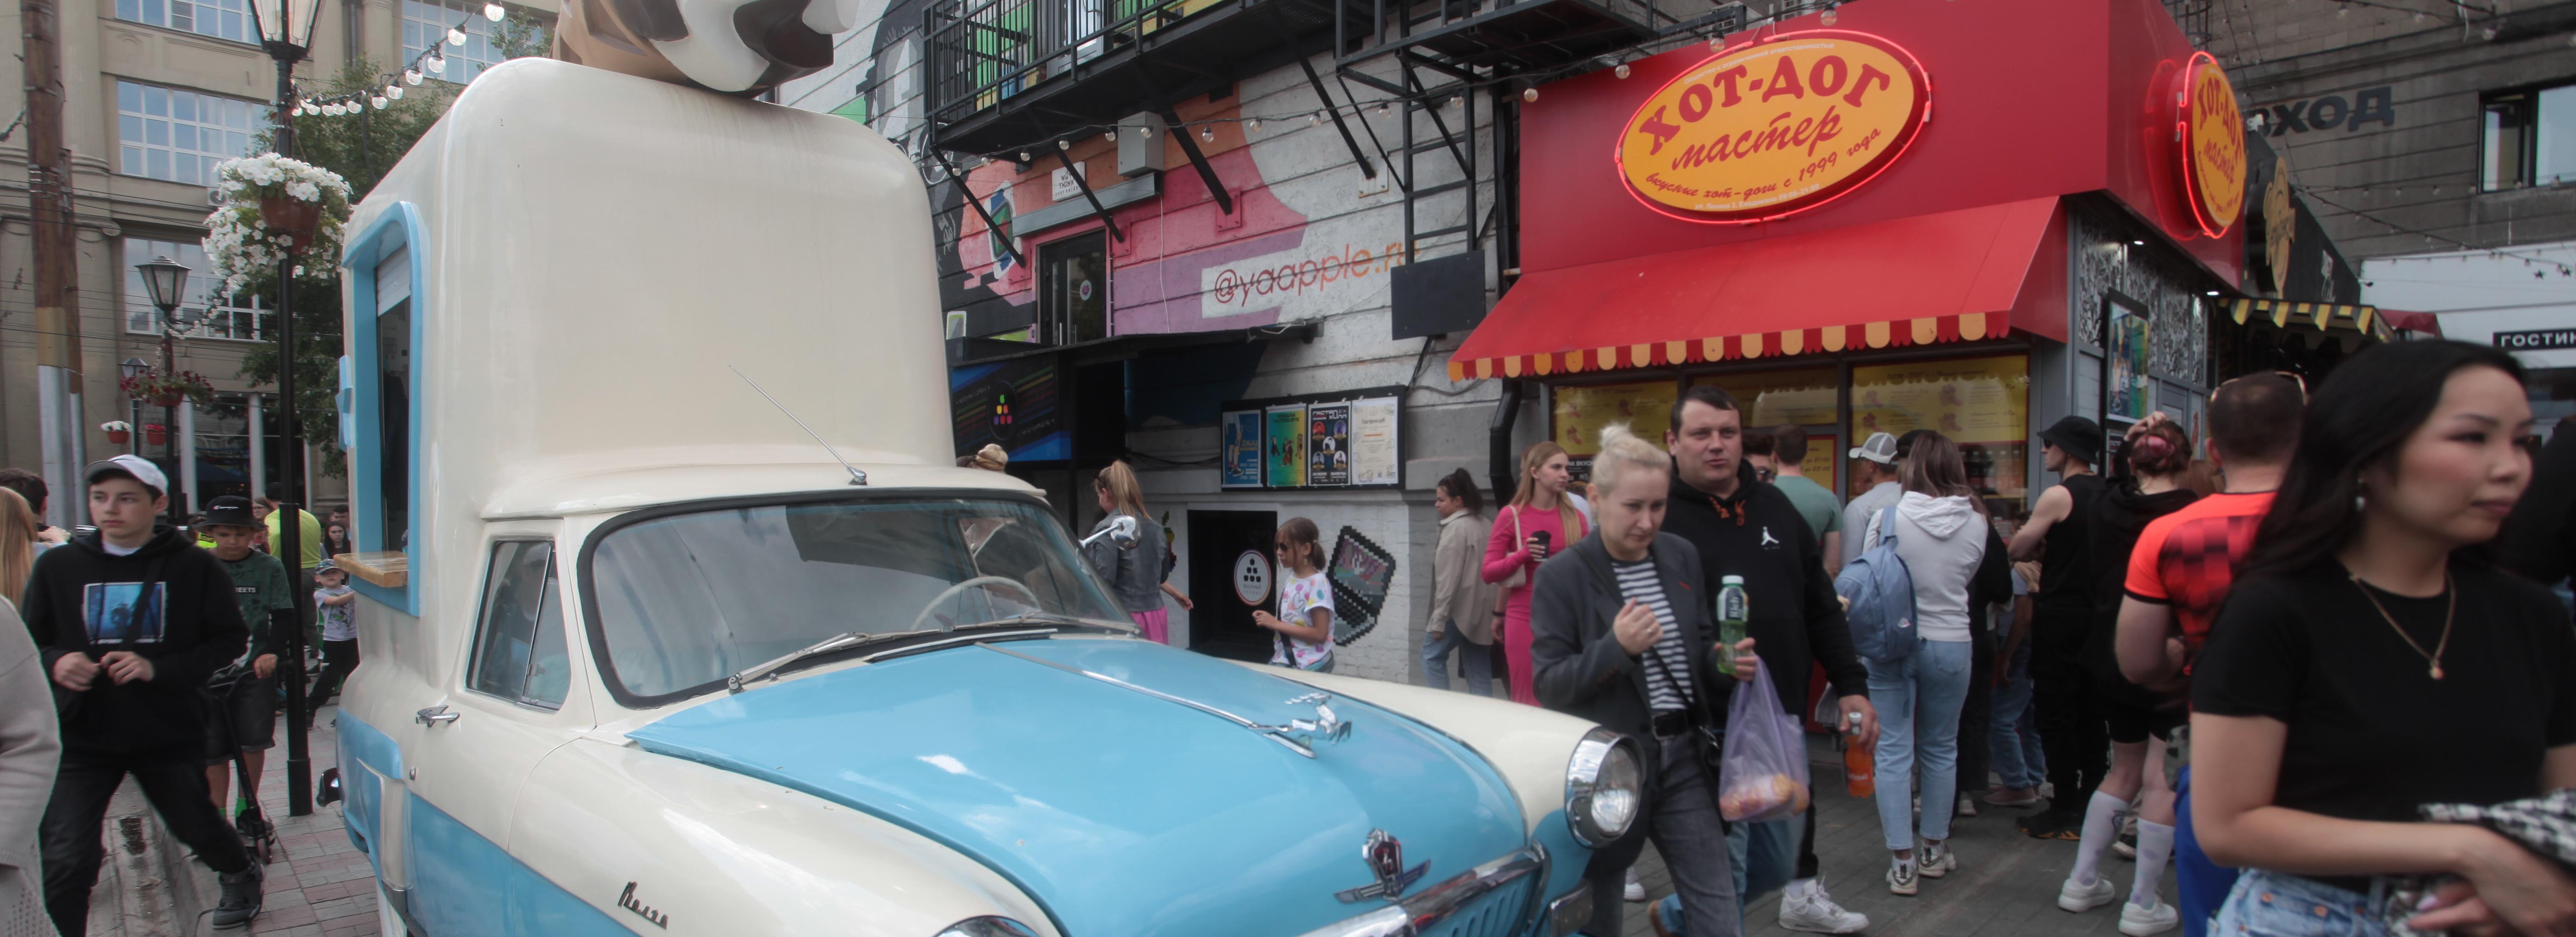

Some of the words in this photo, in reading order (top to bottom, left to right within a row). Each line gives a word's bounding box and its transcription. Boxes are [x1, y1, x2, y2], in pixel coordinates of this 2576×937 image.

[1639, 55, 1891, 155] ХОТ-ДОГ
[1671, 105, 1842, 171] мастер
[1646, 172, 1698, 197] вкусные
[1703, 182, 1777, 202] хот-доги
[1783, 178, 1792, 188] с
[1799, 151, 1838, 182] 1999
[1847, 128, 1882, 157] года
